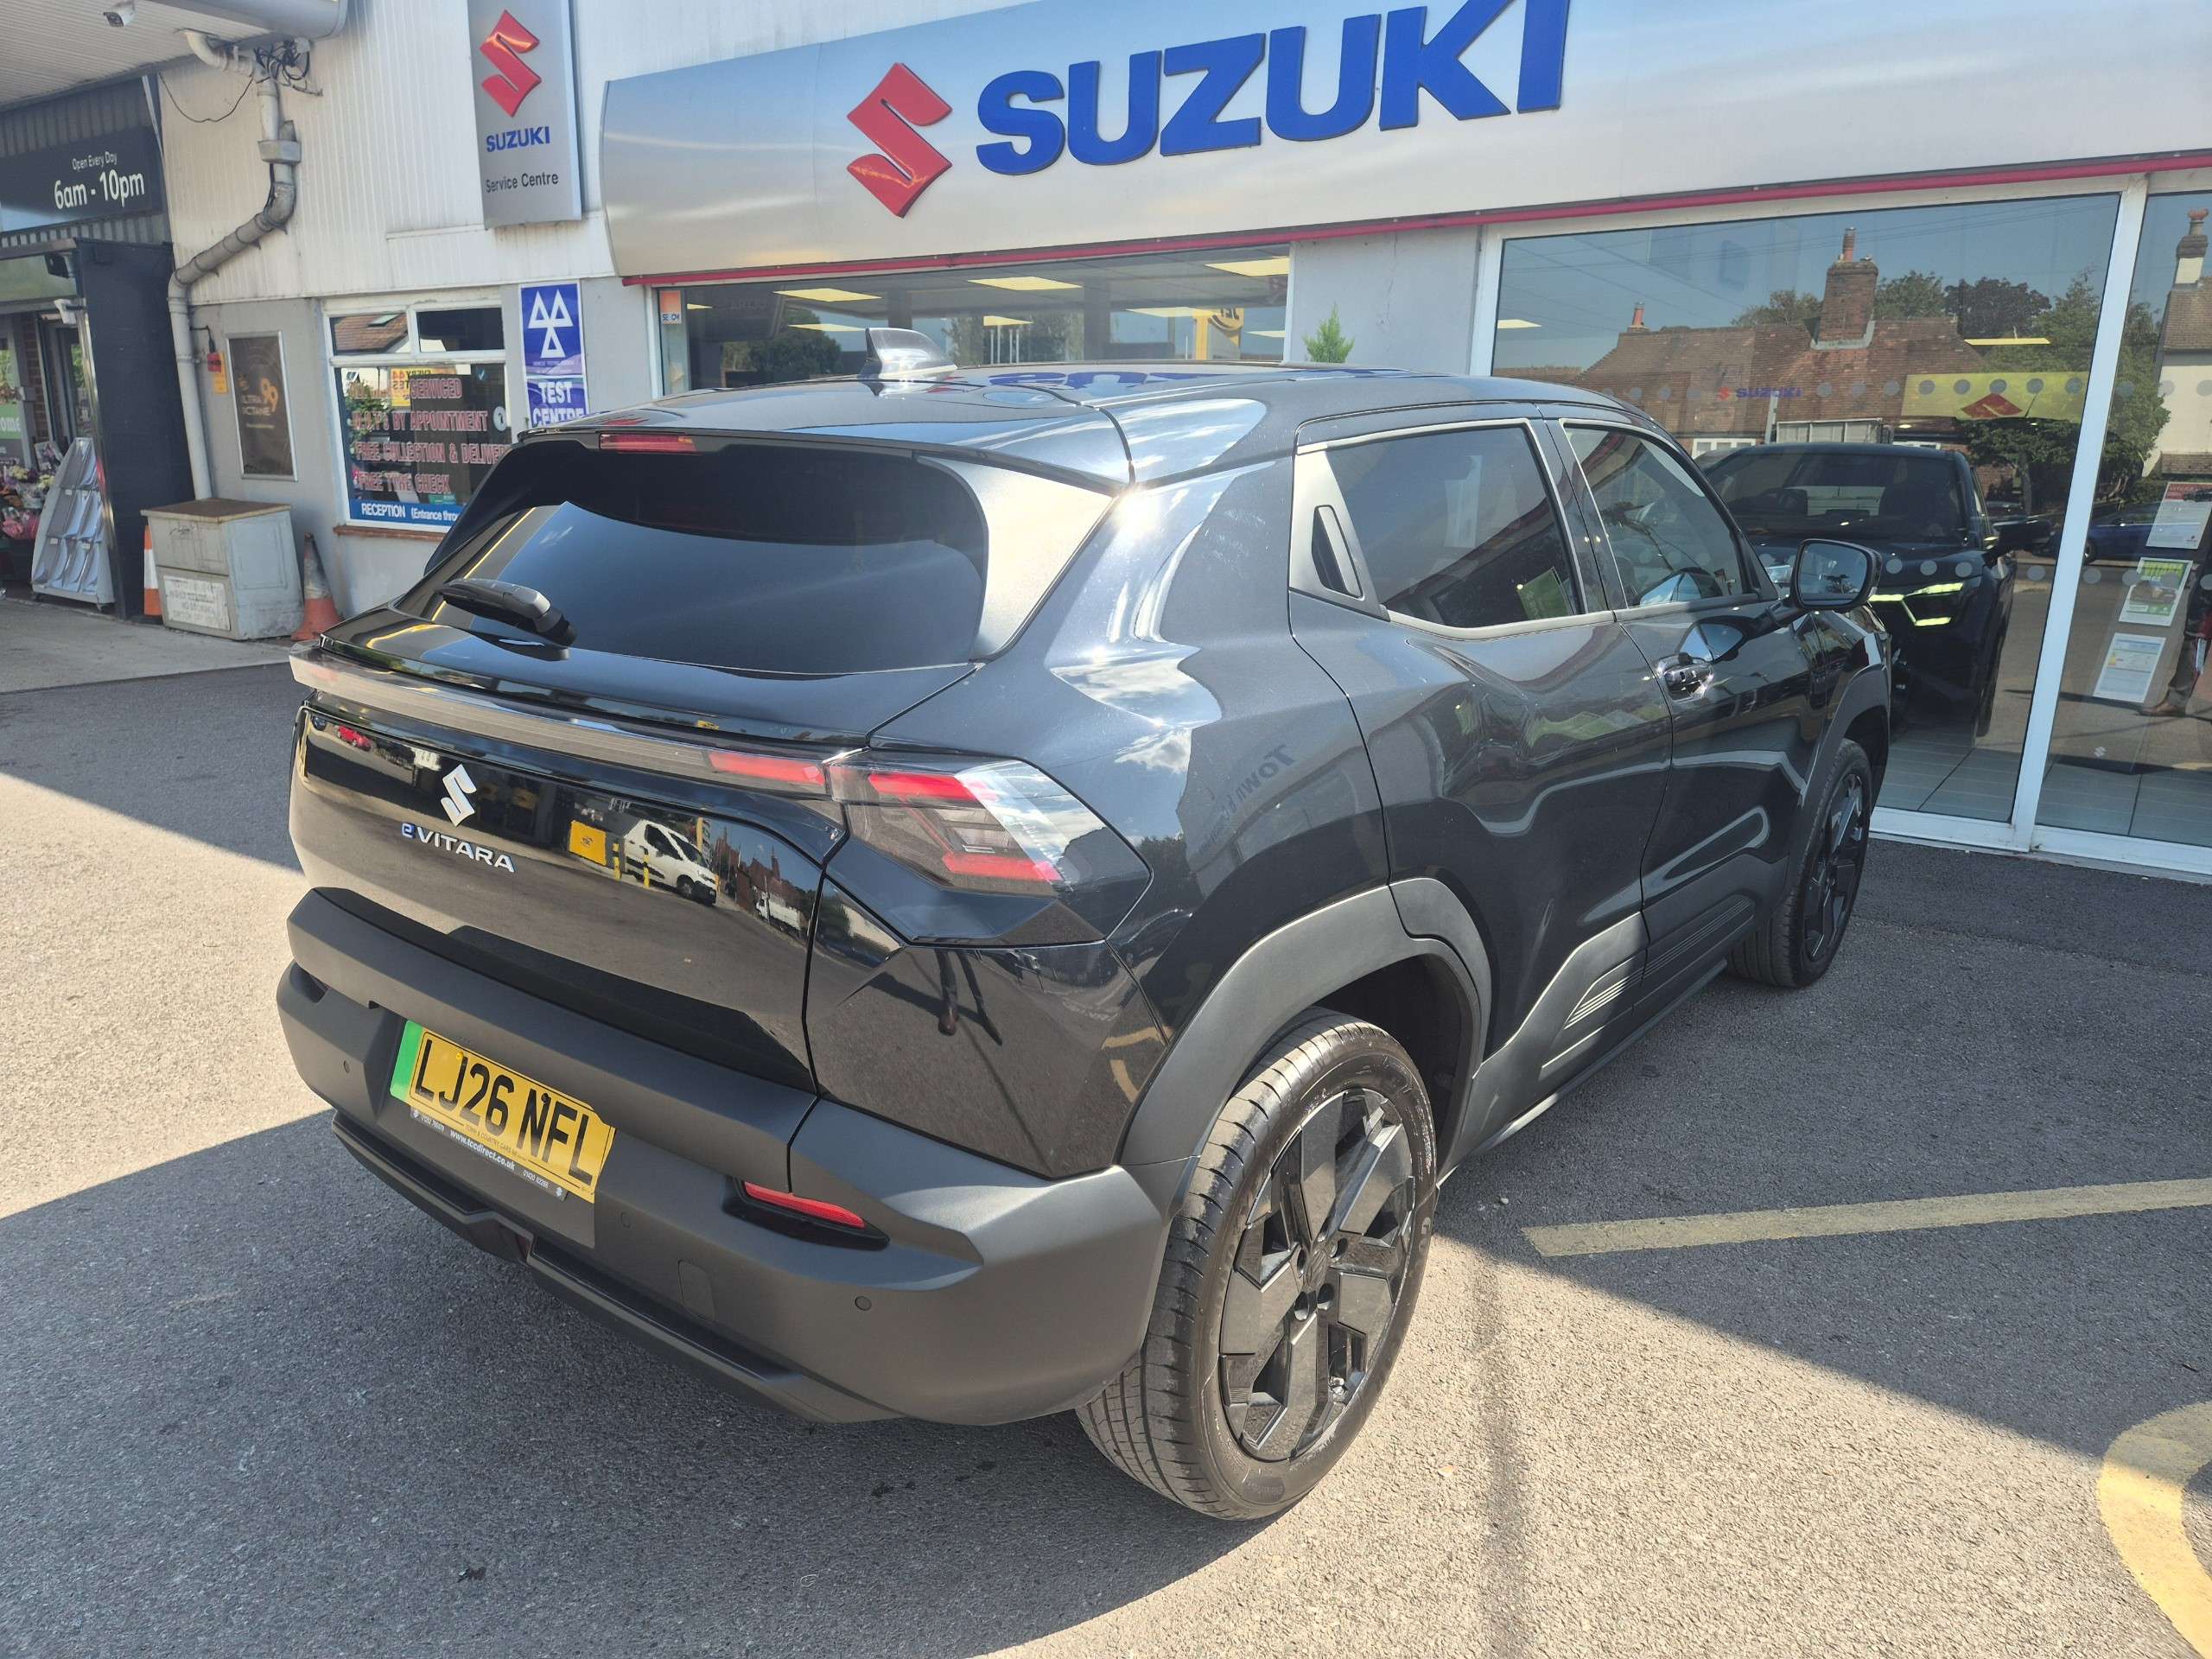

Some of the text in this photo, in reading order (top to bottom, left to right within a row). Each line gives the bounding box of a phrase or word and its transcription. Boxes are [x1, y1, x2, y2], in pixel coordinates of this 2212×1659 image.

[976, 0, 1570, 175] SUZUKI
[486, 126, 550, 152] SUZUKI
[72, 151, 118, 171] Open Every Day
[54, 179, 87, 209] 6am
[99, 168, 145, 207] 10pm
[486, 172, 559, 193] Service Centre
[537, 381, 573, 404] TEST
[410, 410, 489, 432] APPOINTMENT
[355, 442, 381, 461] FREE
[383, 442, 446, 462] COLLECTION
[448, 443, 459, 463] &
[414, 474, 452, 494] CHECK
[361, 503, 406, 518] RECEPTION
[410, 507, 442, 520] (Entrance
[415, 1039, 594, 1186] LJ26 NFL
[450, 1129, 516, 1171] www.tccdirect.co.uk
